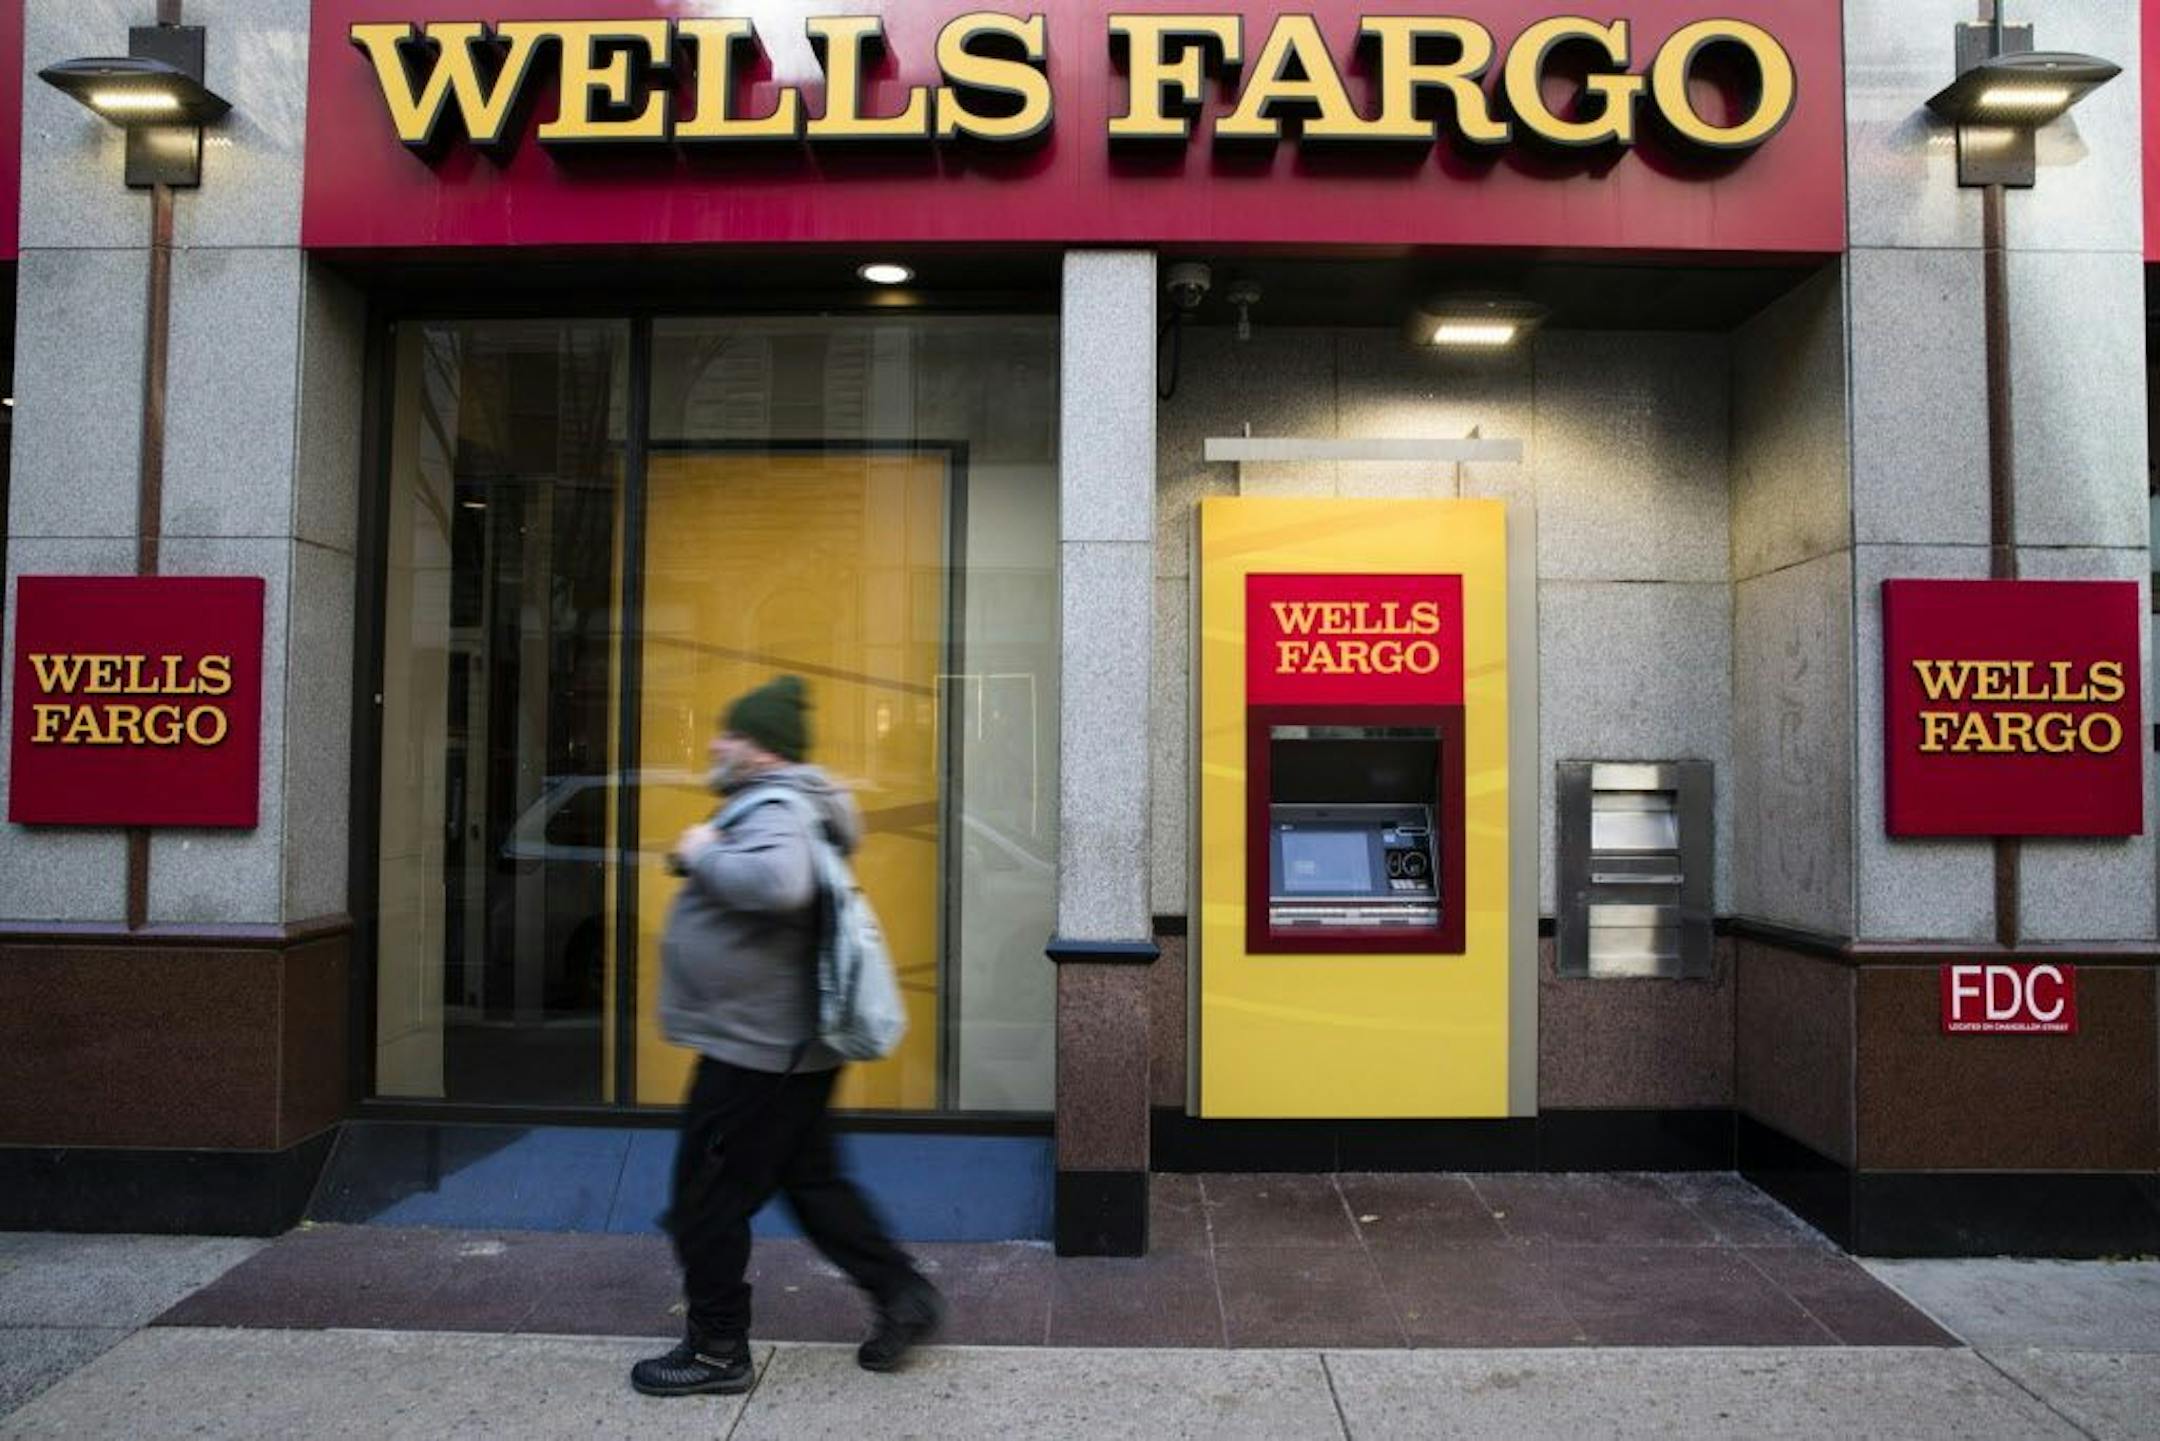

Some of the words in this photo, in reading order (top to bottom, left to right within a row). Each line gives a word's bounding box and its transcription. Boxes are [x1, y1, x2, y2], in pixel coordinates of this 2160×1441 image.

[350, 12, 1053, 143] WELLS
[1108, 12, 1796, 145] FARGO
[1271, 602, 1440, 635] WELLS
[28, 653, 232, 695] WELLS
[1276, 640, 1440, 674] FARGO
[1912, 660, 2125, 702] WELLS
[31, 704, 228, 745] FARGO
[1919, 712, 2123, 753] FARGO
[1952, 965, 2064, 1021] FDC
